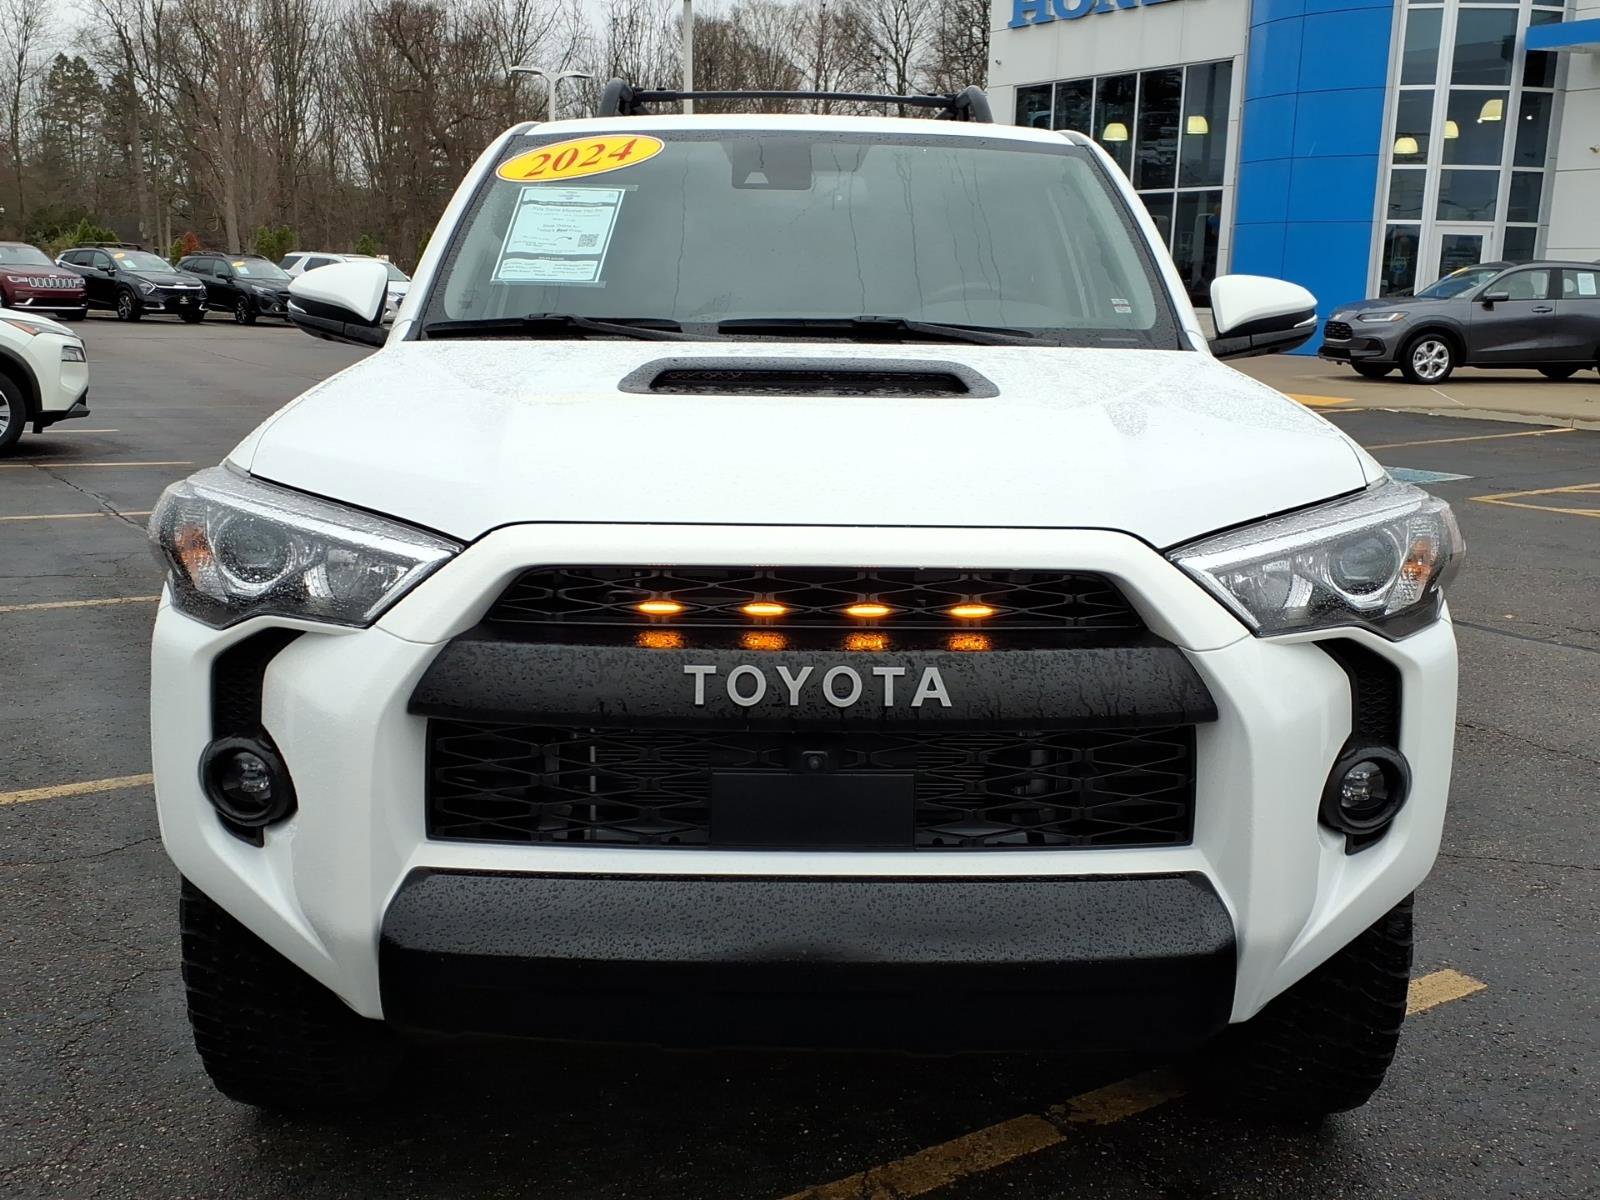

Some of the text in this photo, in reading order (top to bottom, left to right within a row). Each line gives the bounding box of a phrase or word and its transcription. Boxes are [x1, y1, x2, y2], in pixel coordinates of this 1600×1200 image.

[1008, 0, 1178, 28] HO
[523, 138, 638, 178] 2024
[683, 664, 952, 708] TOYOTA
